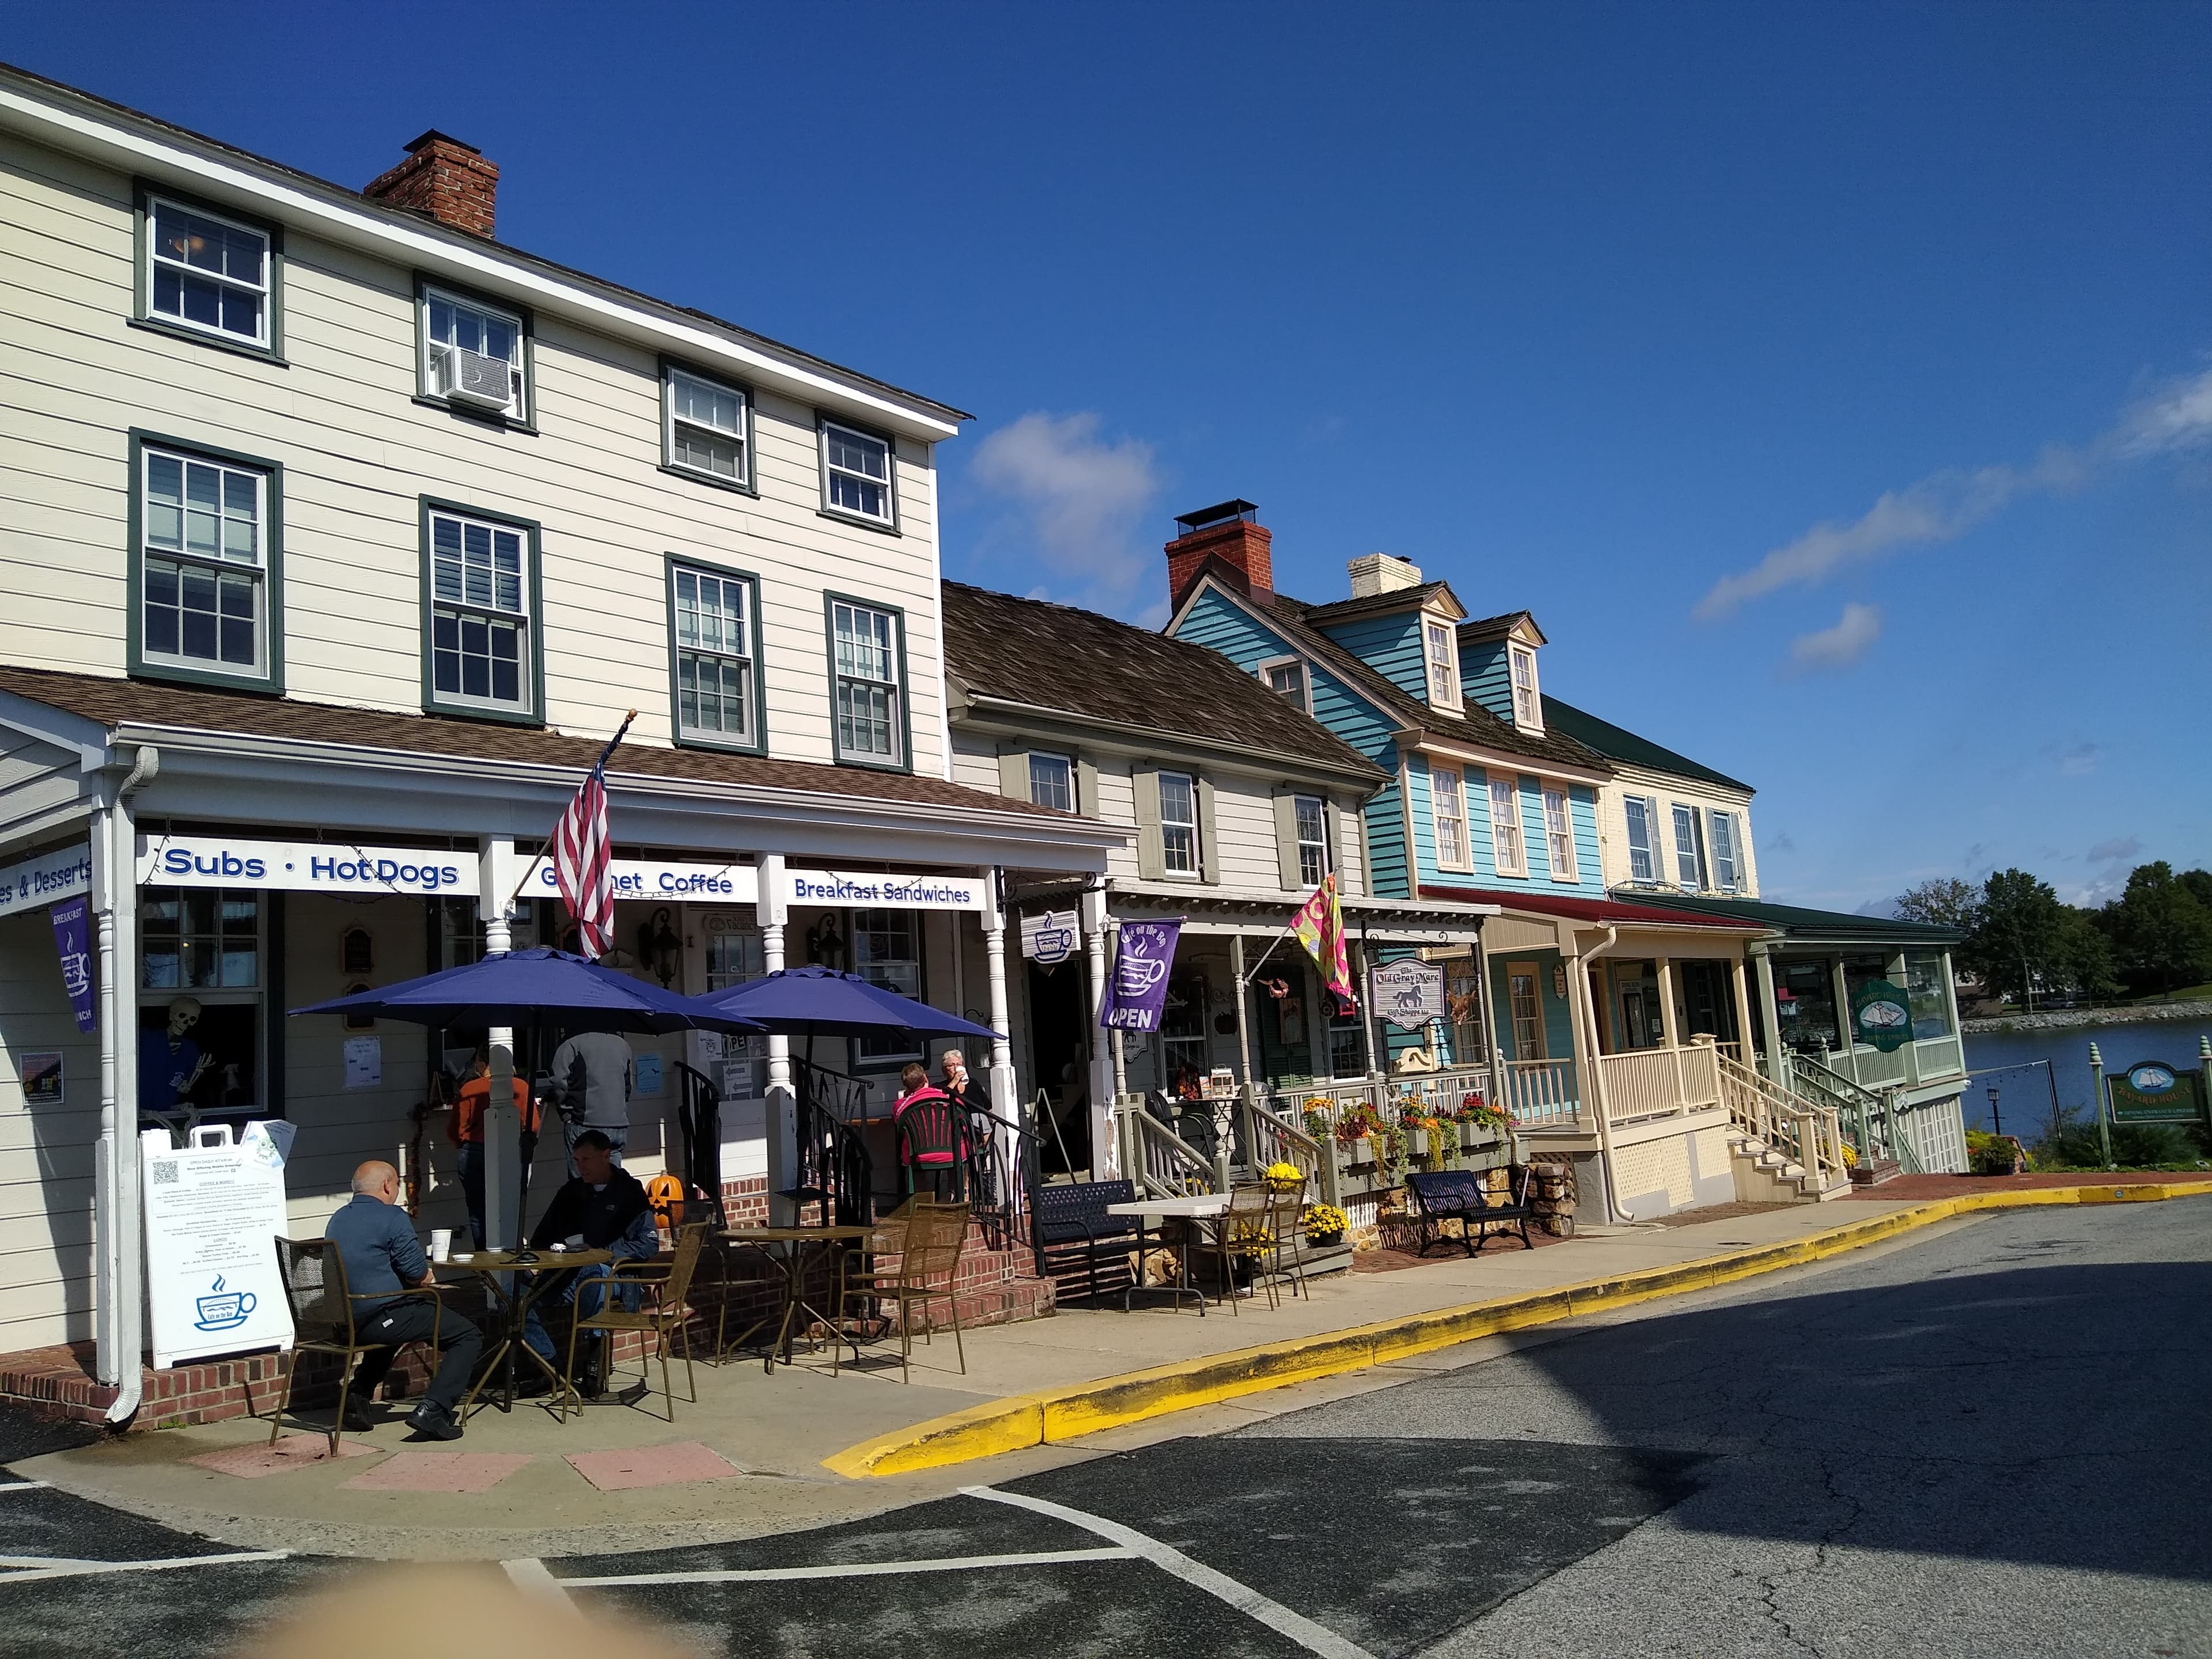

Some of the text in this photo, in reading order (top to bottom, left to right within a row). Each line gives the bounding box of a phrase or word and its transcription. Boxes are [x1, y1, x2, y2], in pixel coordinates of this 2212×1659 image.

[20, 875, 29, 898] &
[35, 857, 92, 894] Desserts
[165, 849, 459, 889] Subs Hot Dogs
[658, 873, 733, 893] Coffee
[795, 879, 971, 903] Breakfast Sandwiches
[53, 907, 82, 925] BREAKFAST
[1136, 926, 1145, 935] on
[1146, 925, 1157, 937] the
[1376, 972, 1439, 985] Old Gray Mare
[1108, 1007, 1152, 1028] OPEN
[1388, 1009, 1399, 1017] Gift
[1400, 1009, 1420, 1017] Shoppe
[2118, 1086, 2191, 1105] BAYARD HOUSE
